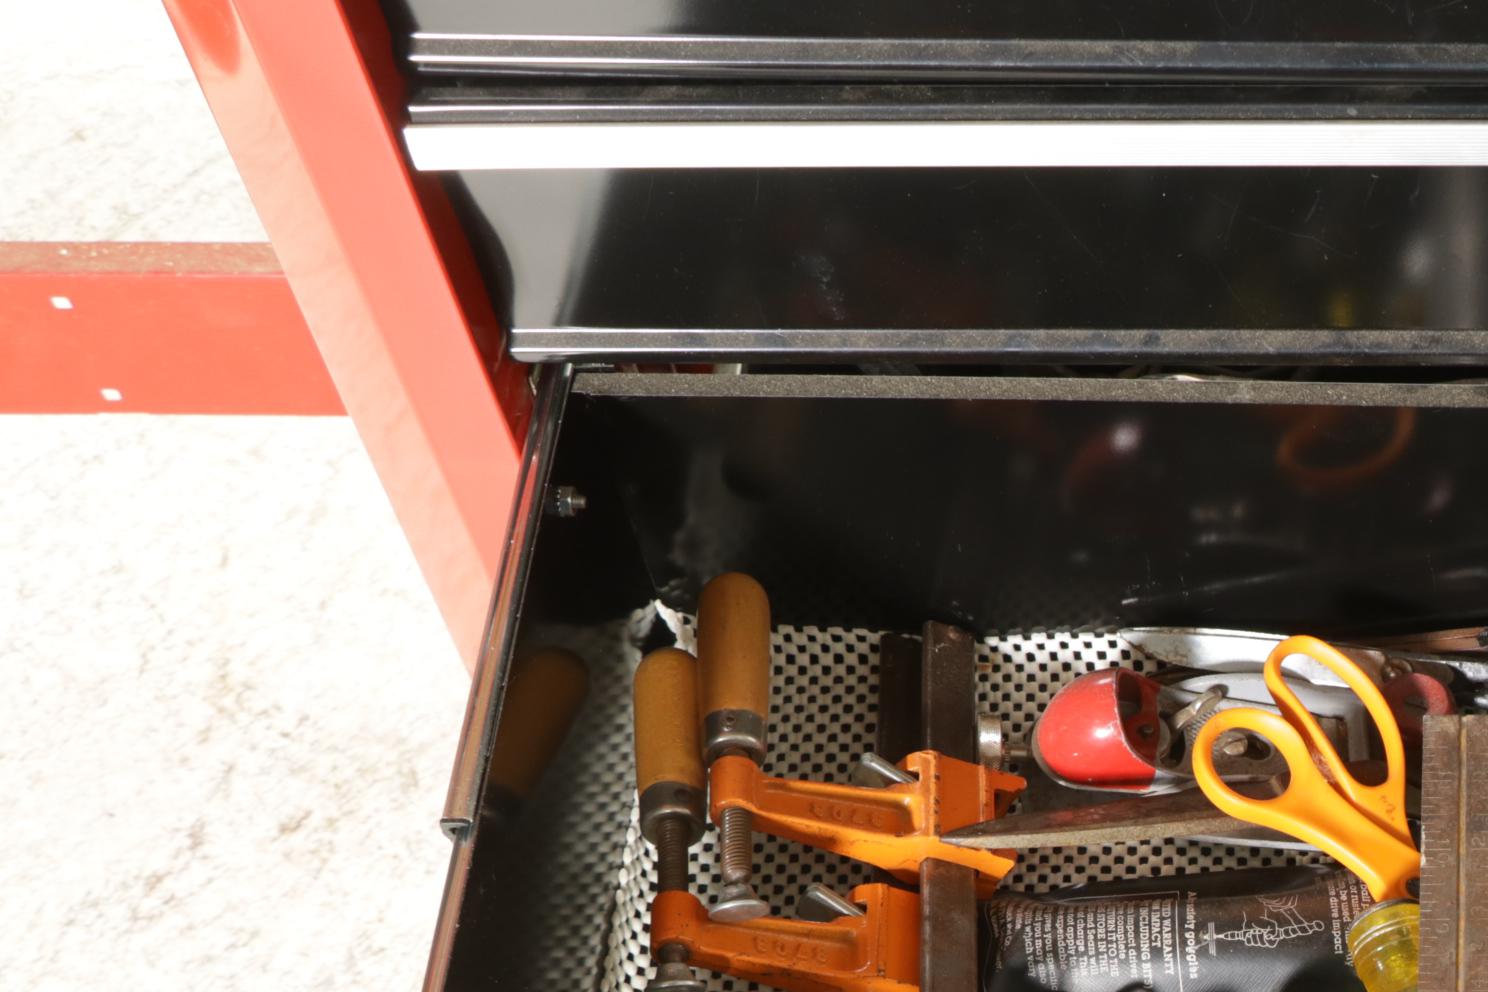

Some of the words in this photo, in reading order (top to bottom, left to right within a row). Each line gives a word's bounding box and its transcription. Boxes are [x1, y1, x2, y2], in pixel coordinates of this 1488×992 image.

[1329, 896, 1339, 917] drive
[1043, 932, 1052, 951] you
[1065, 926, 1075, 954] apply
[1116, 914, 1126, 959] complete
[1139, 907, 1149, 960] INCLUDING
[1151, 911, 1161, 947] IMPACT
[1162, 918, 1174, 974] WARRANTY
[1332, 919, 1343, 955] impact
